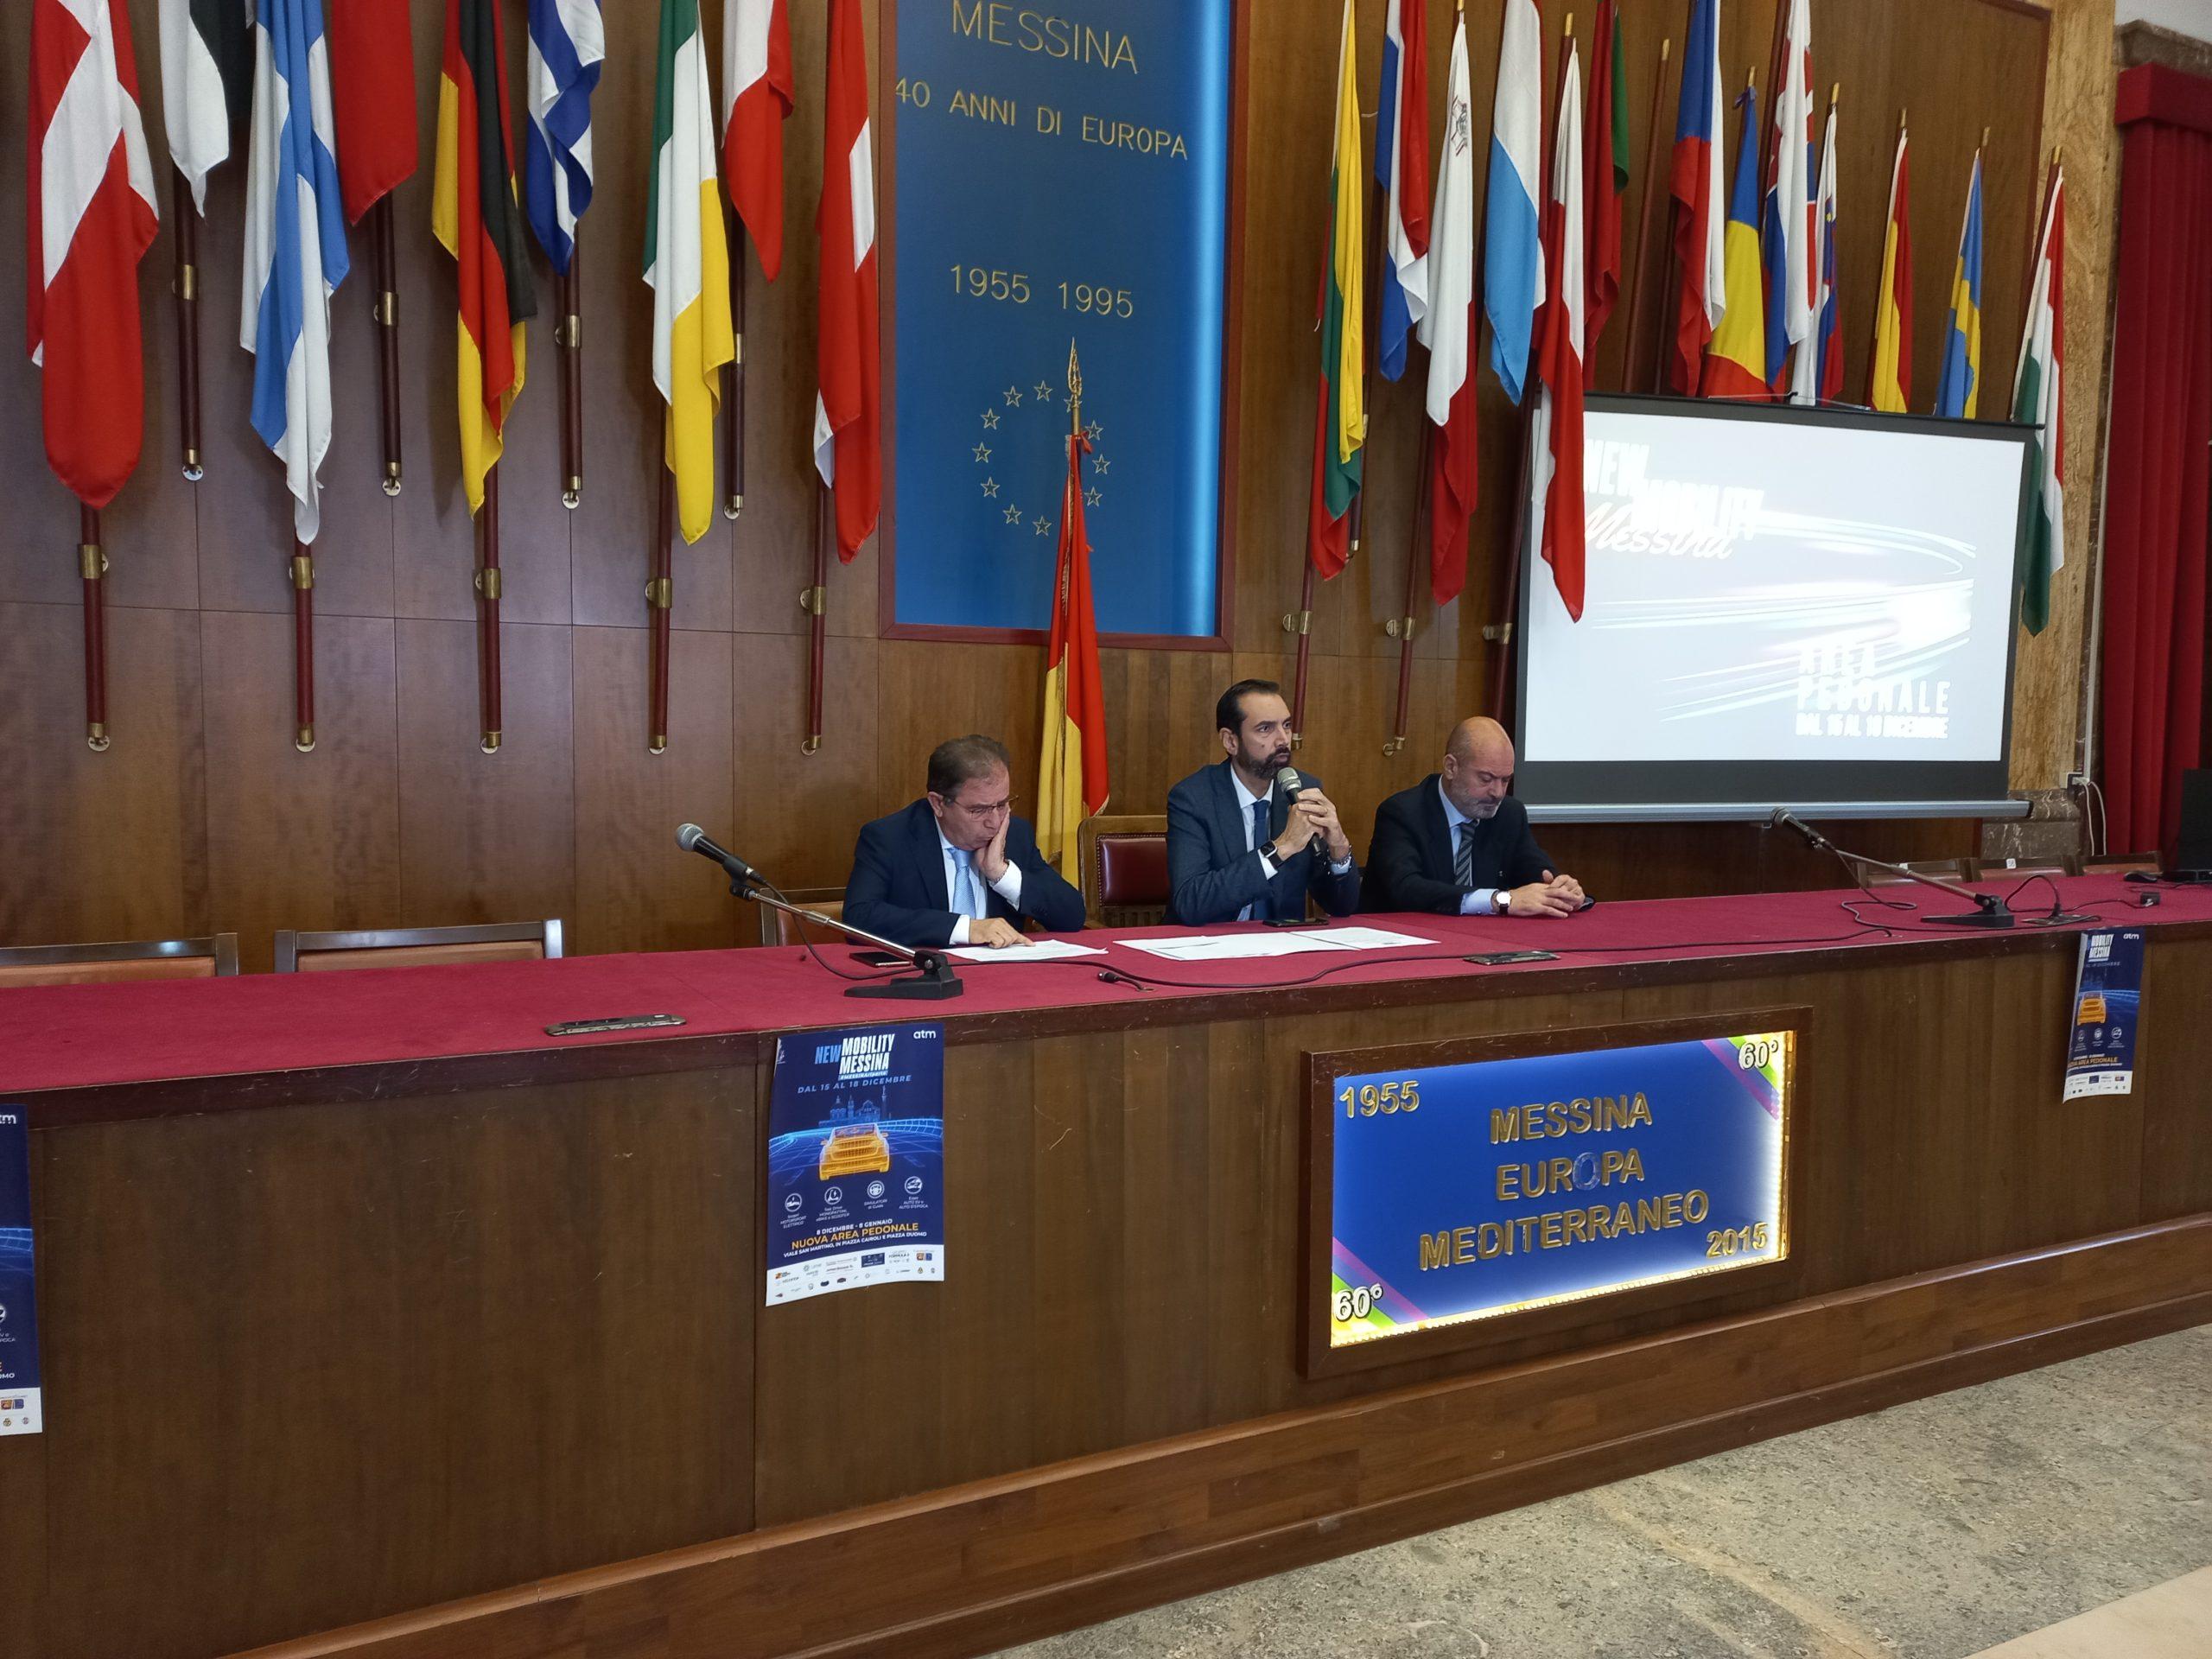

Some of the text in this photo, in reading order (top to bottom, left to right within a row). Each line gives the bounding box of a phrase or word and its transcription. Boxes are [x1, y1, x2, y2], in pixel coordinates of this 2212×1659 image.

[951, 0, 1138, 74] MESSINA
[896, 78, 1188, 161] 40 ANNI DI EUROPA
[950, 264, 1134, 318] 1955 1995
[1584, 439, 1649, 498] NEW
[1797, 677, 1951, 715] PEDONALE
[815, 1033, 895, 1065] NEW MOBILITY
[913, 1030, 936, 1039] atm
[839, 1052, 890, 1074] MESSINA
[798, 1085, 817, 1094] DAL
[862, 1075, 912, 1086] DICEMBRE
[1339, 1080, 1421, 1119] 1955
[1490, 1092, 1652, 1145] MESSINA
[1496, 1148, 1645, 1201] EUROPA
[791, 1223, 918, 1249] NUOVA AREA PEDONALE
[822, 1224, 854, 1234] DICEMBRE
[864, 1218, 893, 1227] GENNAIO
[1420, 1189, 1709, 1271] MEDITERRANEO
[1706, 1223, 1768, 1260] 2015
